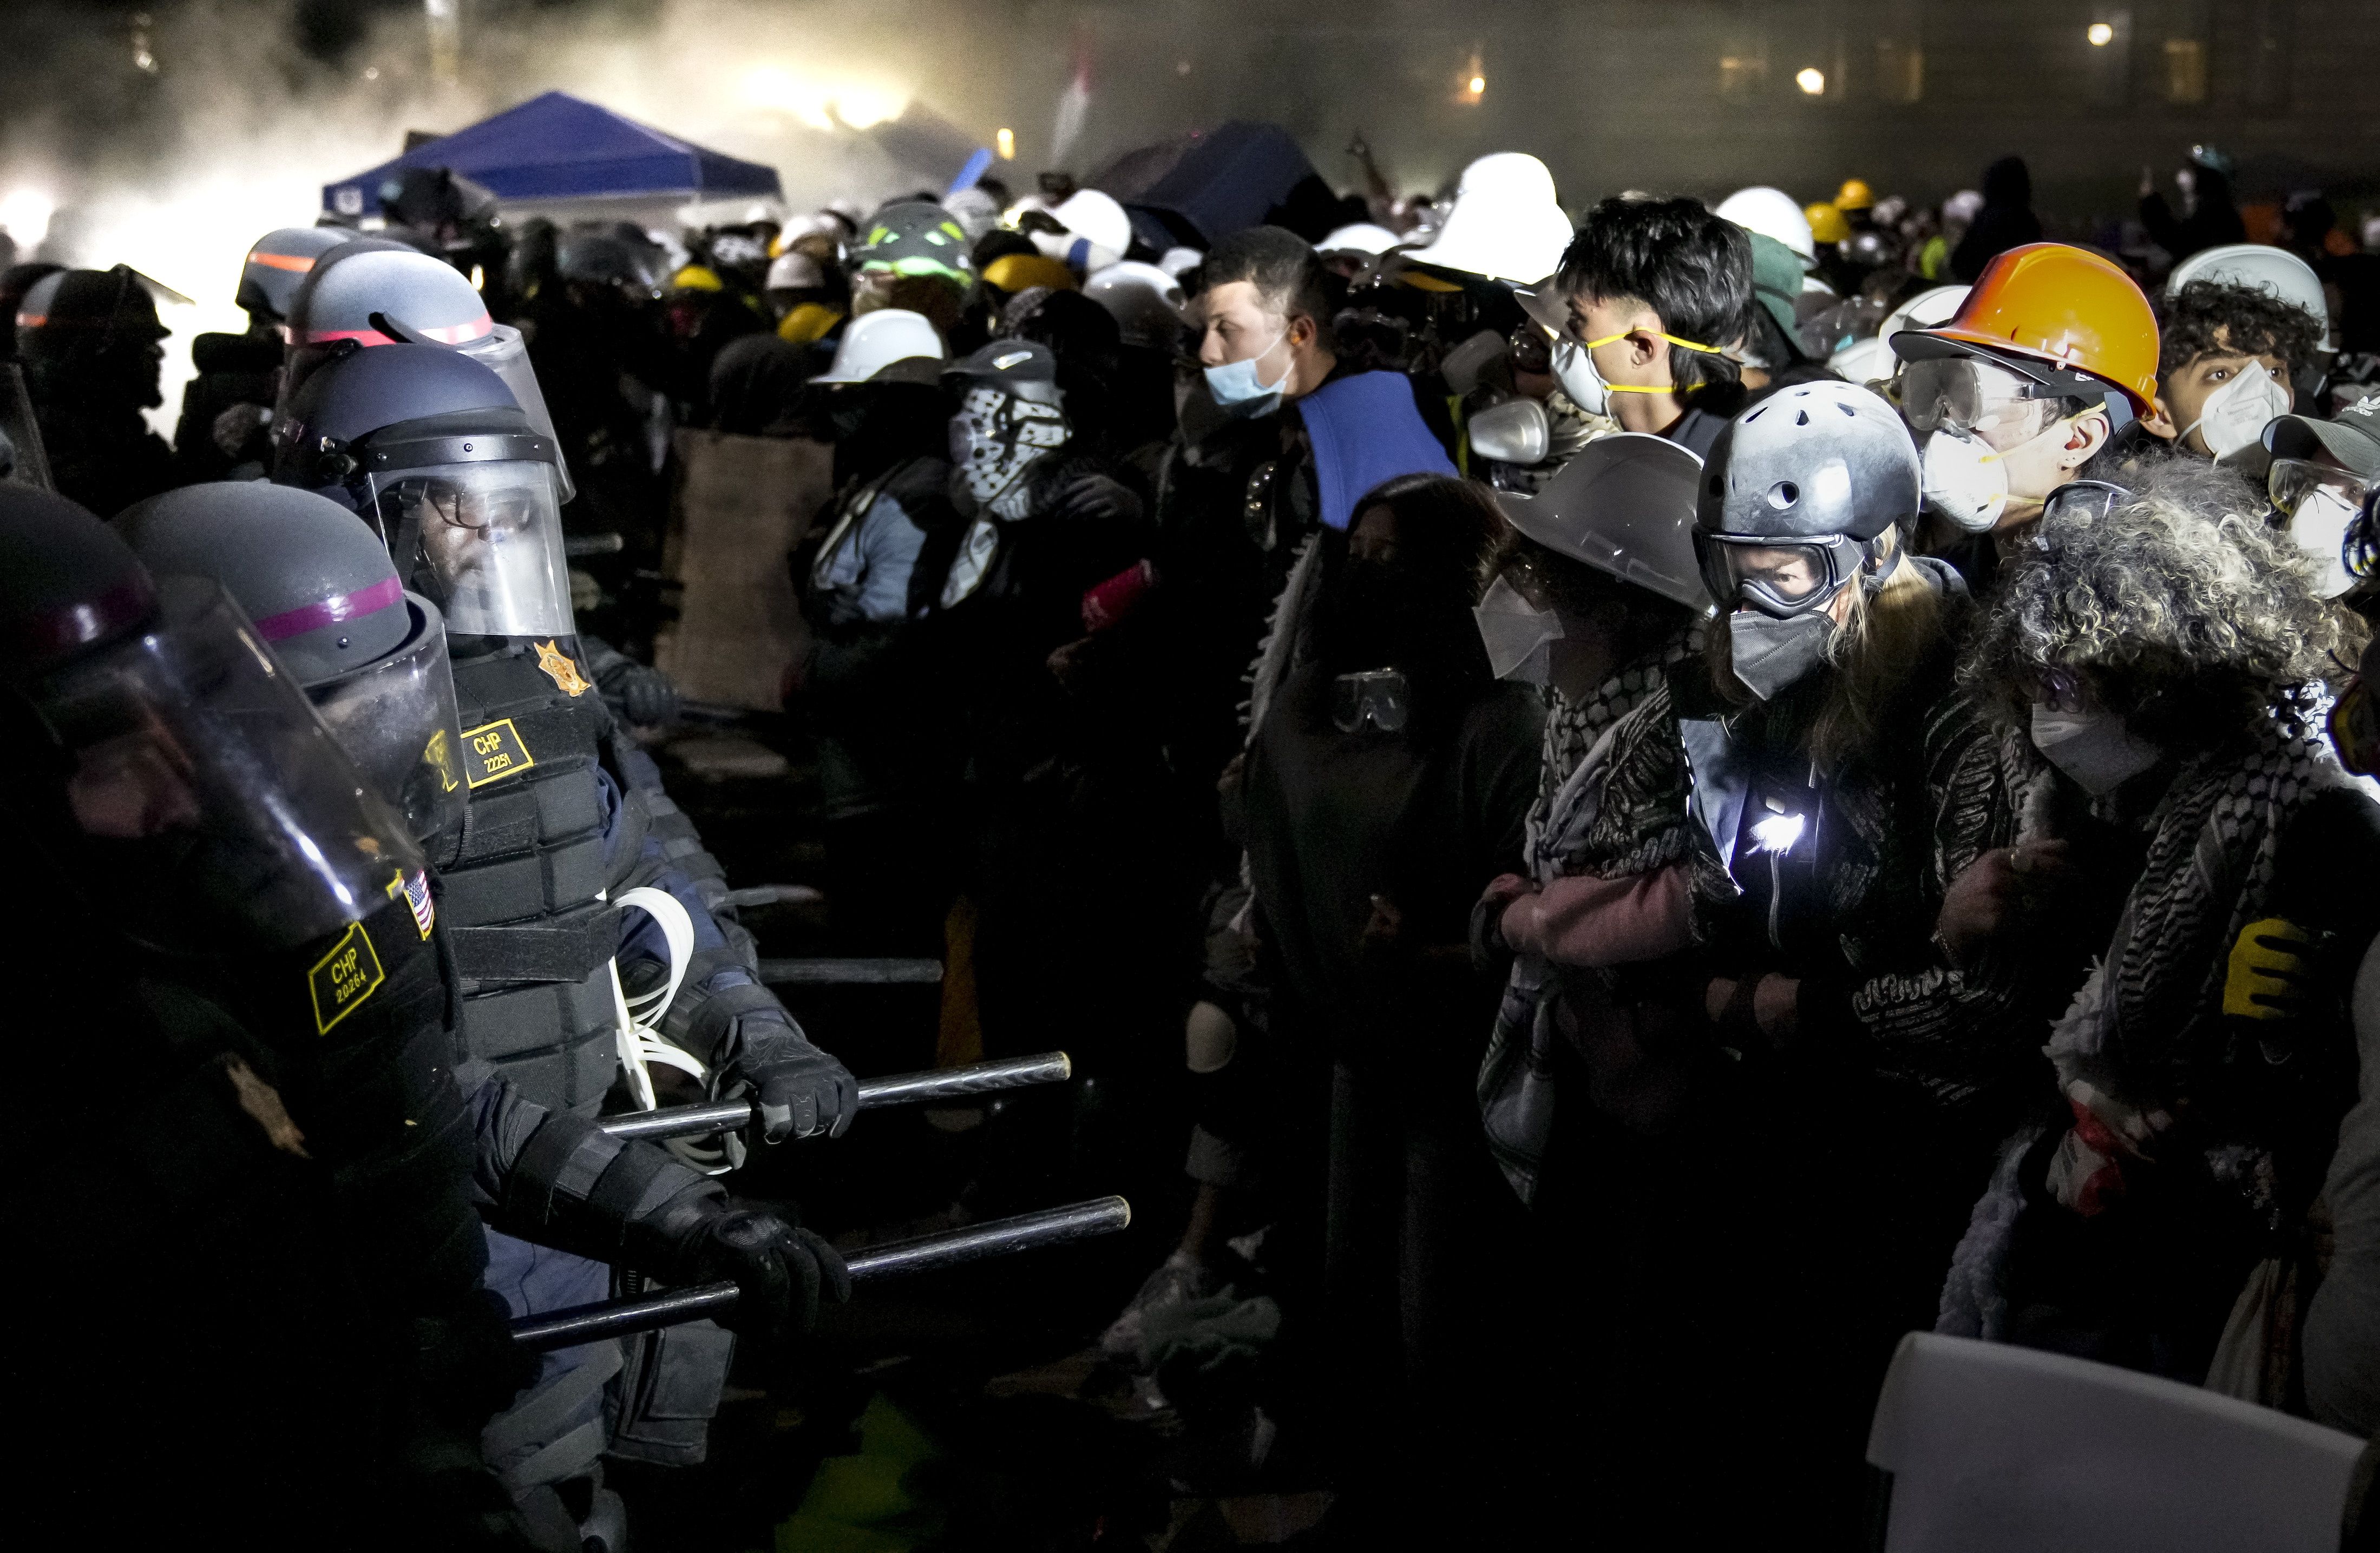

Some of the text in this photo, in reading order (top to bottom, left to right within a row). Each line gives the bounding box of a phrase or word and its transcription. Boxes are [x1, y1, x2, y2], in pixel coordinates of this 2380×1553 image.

[474, 732, 502, 755] CHP
[484, 753, 513, 773] 22251
[331, 947, 357, 984] CHP
[336, 968, 367, 1004] 20264
